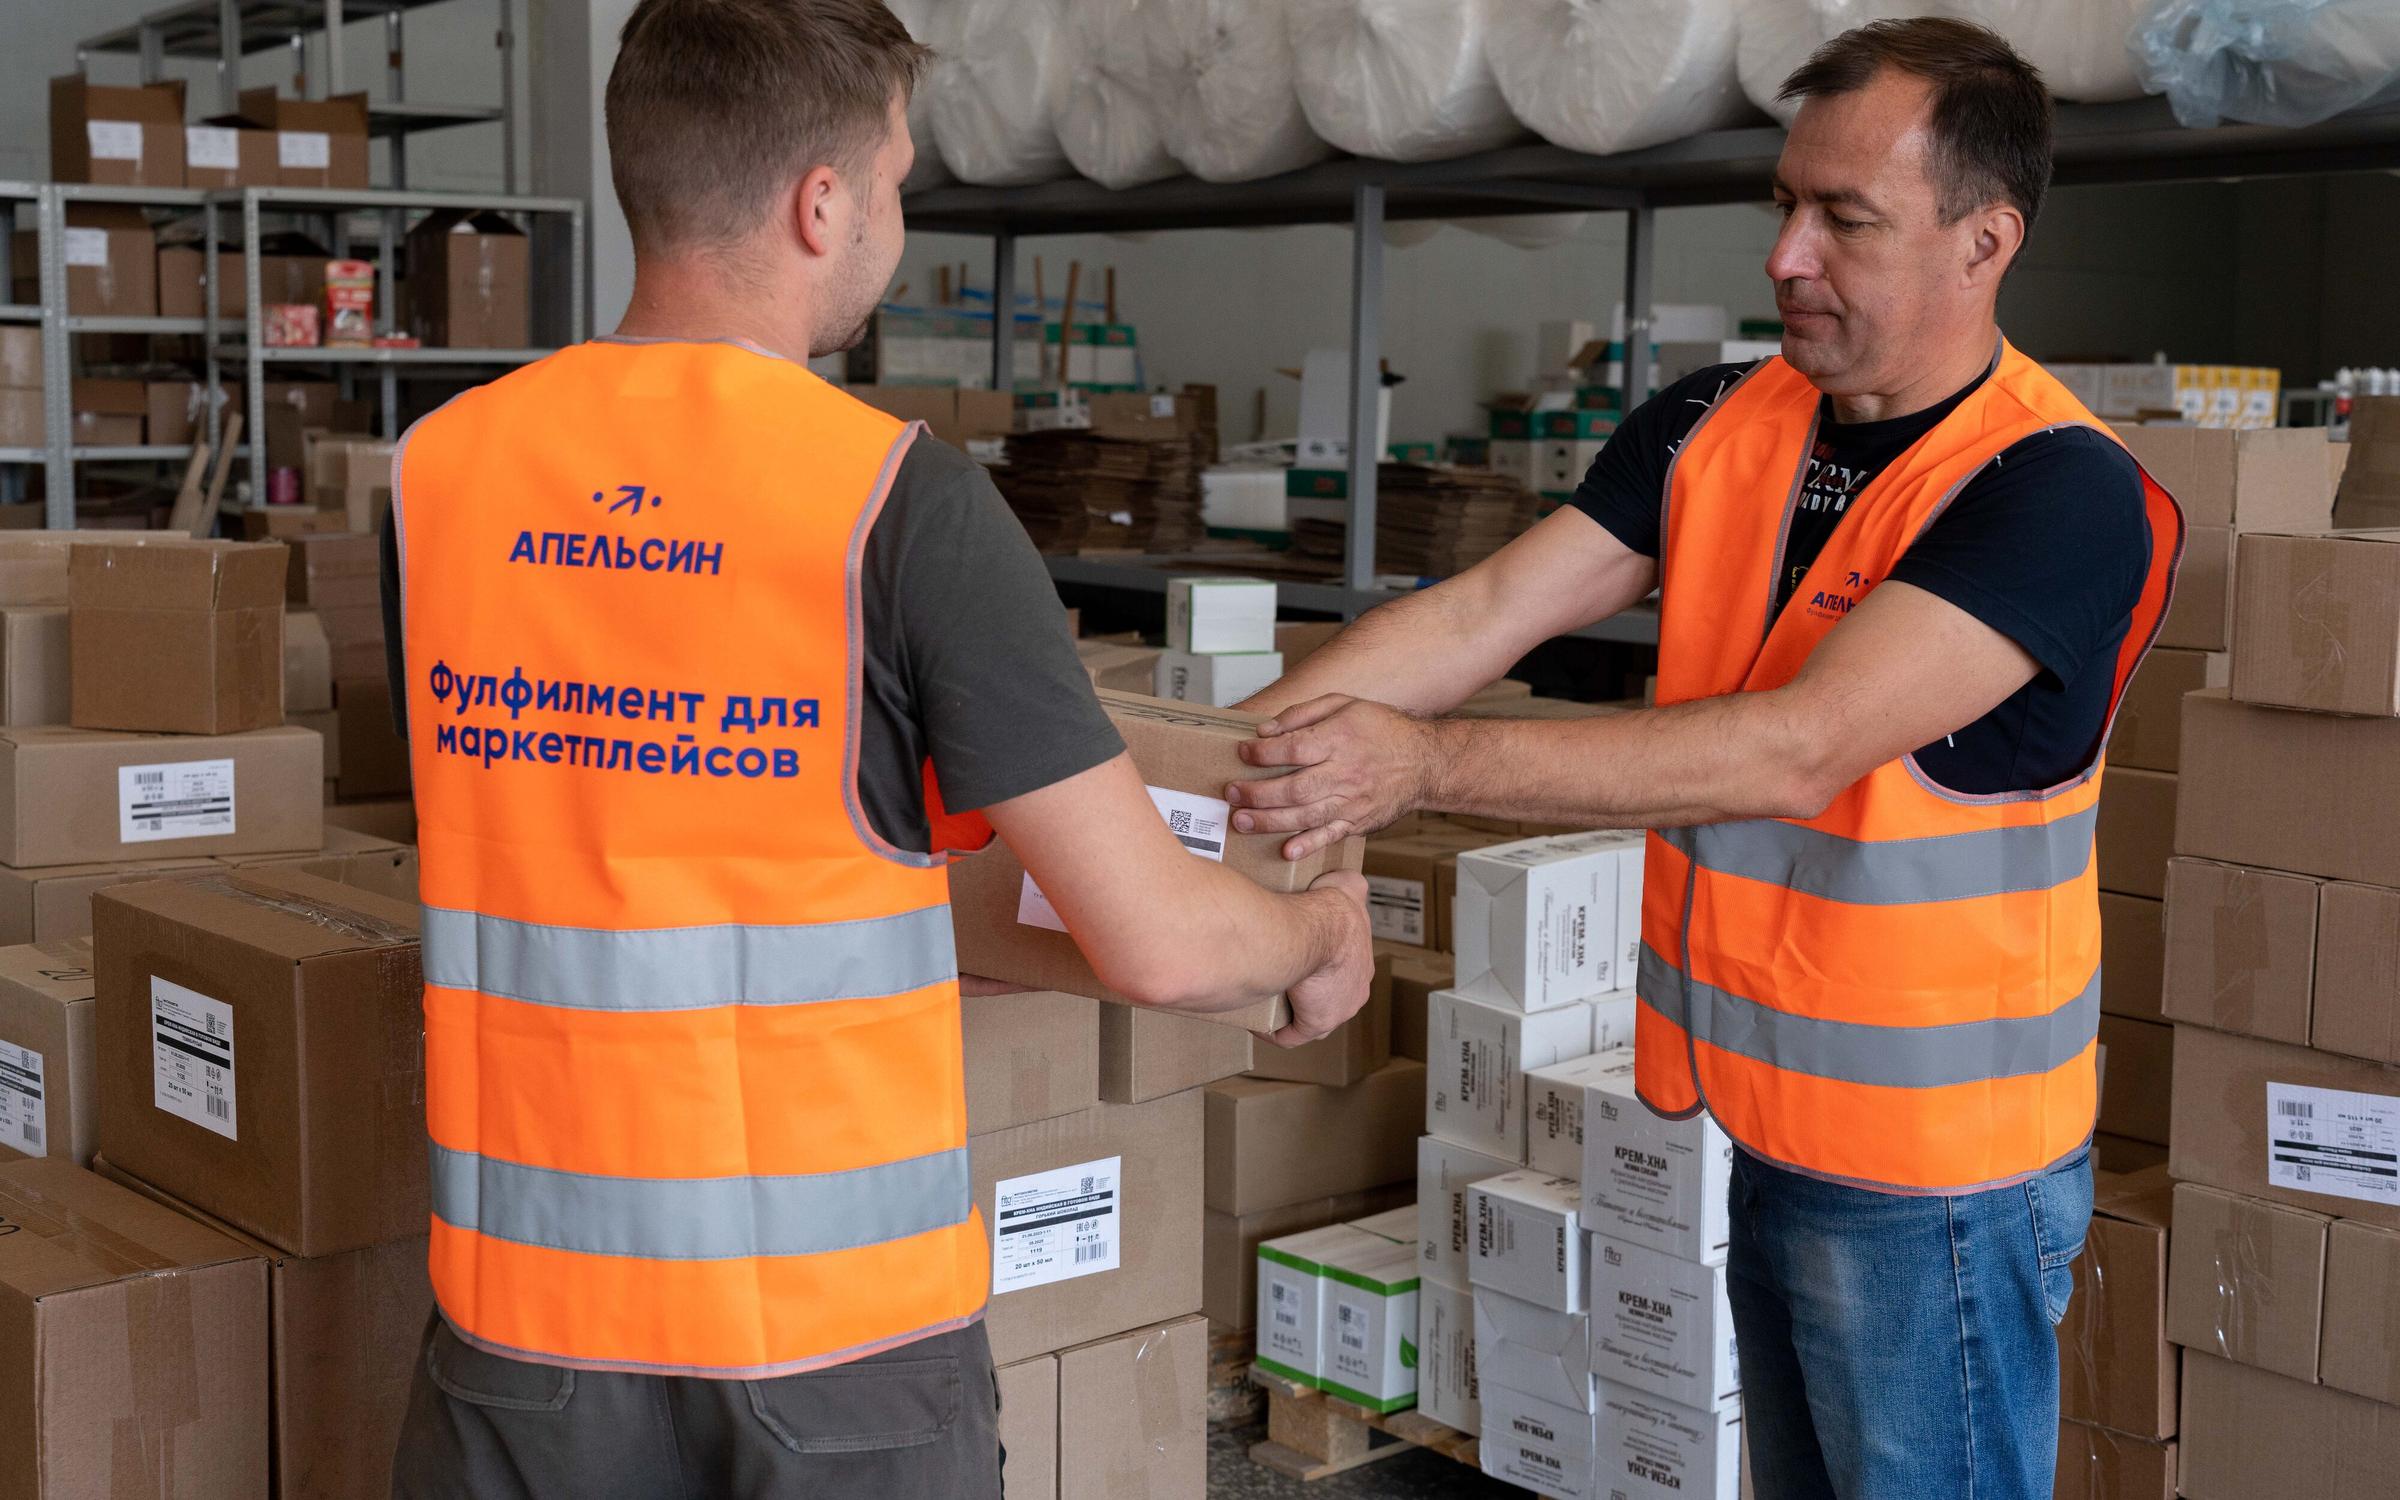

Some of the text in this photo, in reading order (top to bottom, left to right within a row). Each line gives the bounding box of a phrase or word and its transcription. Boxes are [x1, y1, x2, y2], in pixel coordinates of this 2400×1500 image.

[509, 530, 724, 575] АПЕЛЬСИН
[1810, 591, 1856, 613] АПЕЛЬ
[430, 660, 820, 735] Фулфилмент для
[436, 723, 800, 778] маркетплейсов
[1461, 1041, 1470, 1102] КРЕМ-ХНА
[1614, 1146, 1668, 1171] КРЕМ-ХНА
[1452, 1192, 1462, 1253] КРЕМ-ХНА
[1478, 1195, 1488, 1258] КРЕМ-ХНА
[1556, 1227, 1564, 1273] КРЕМ-ХНА
[1618, 1290, 1673, 1318] КРЕМ-ХНА
[1512, 1419, 1554, 1441] КРЕМ-ХНА
[1627, 1460, 1681, 1490] КРЕМ-ХНА
